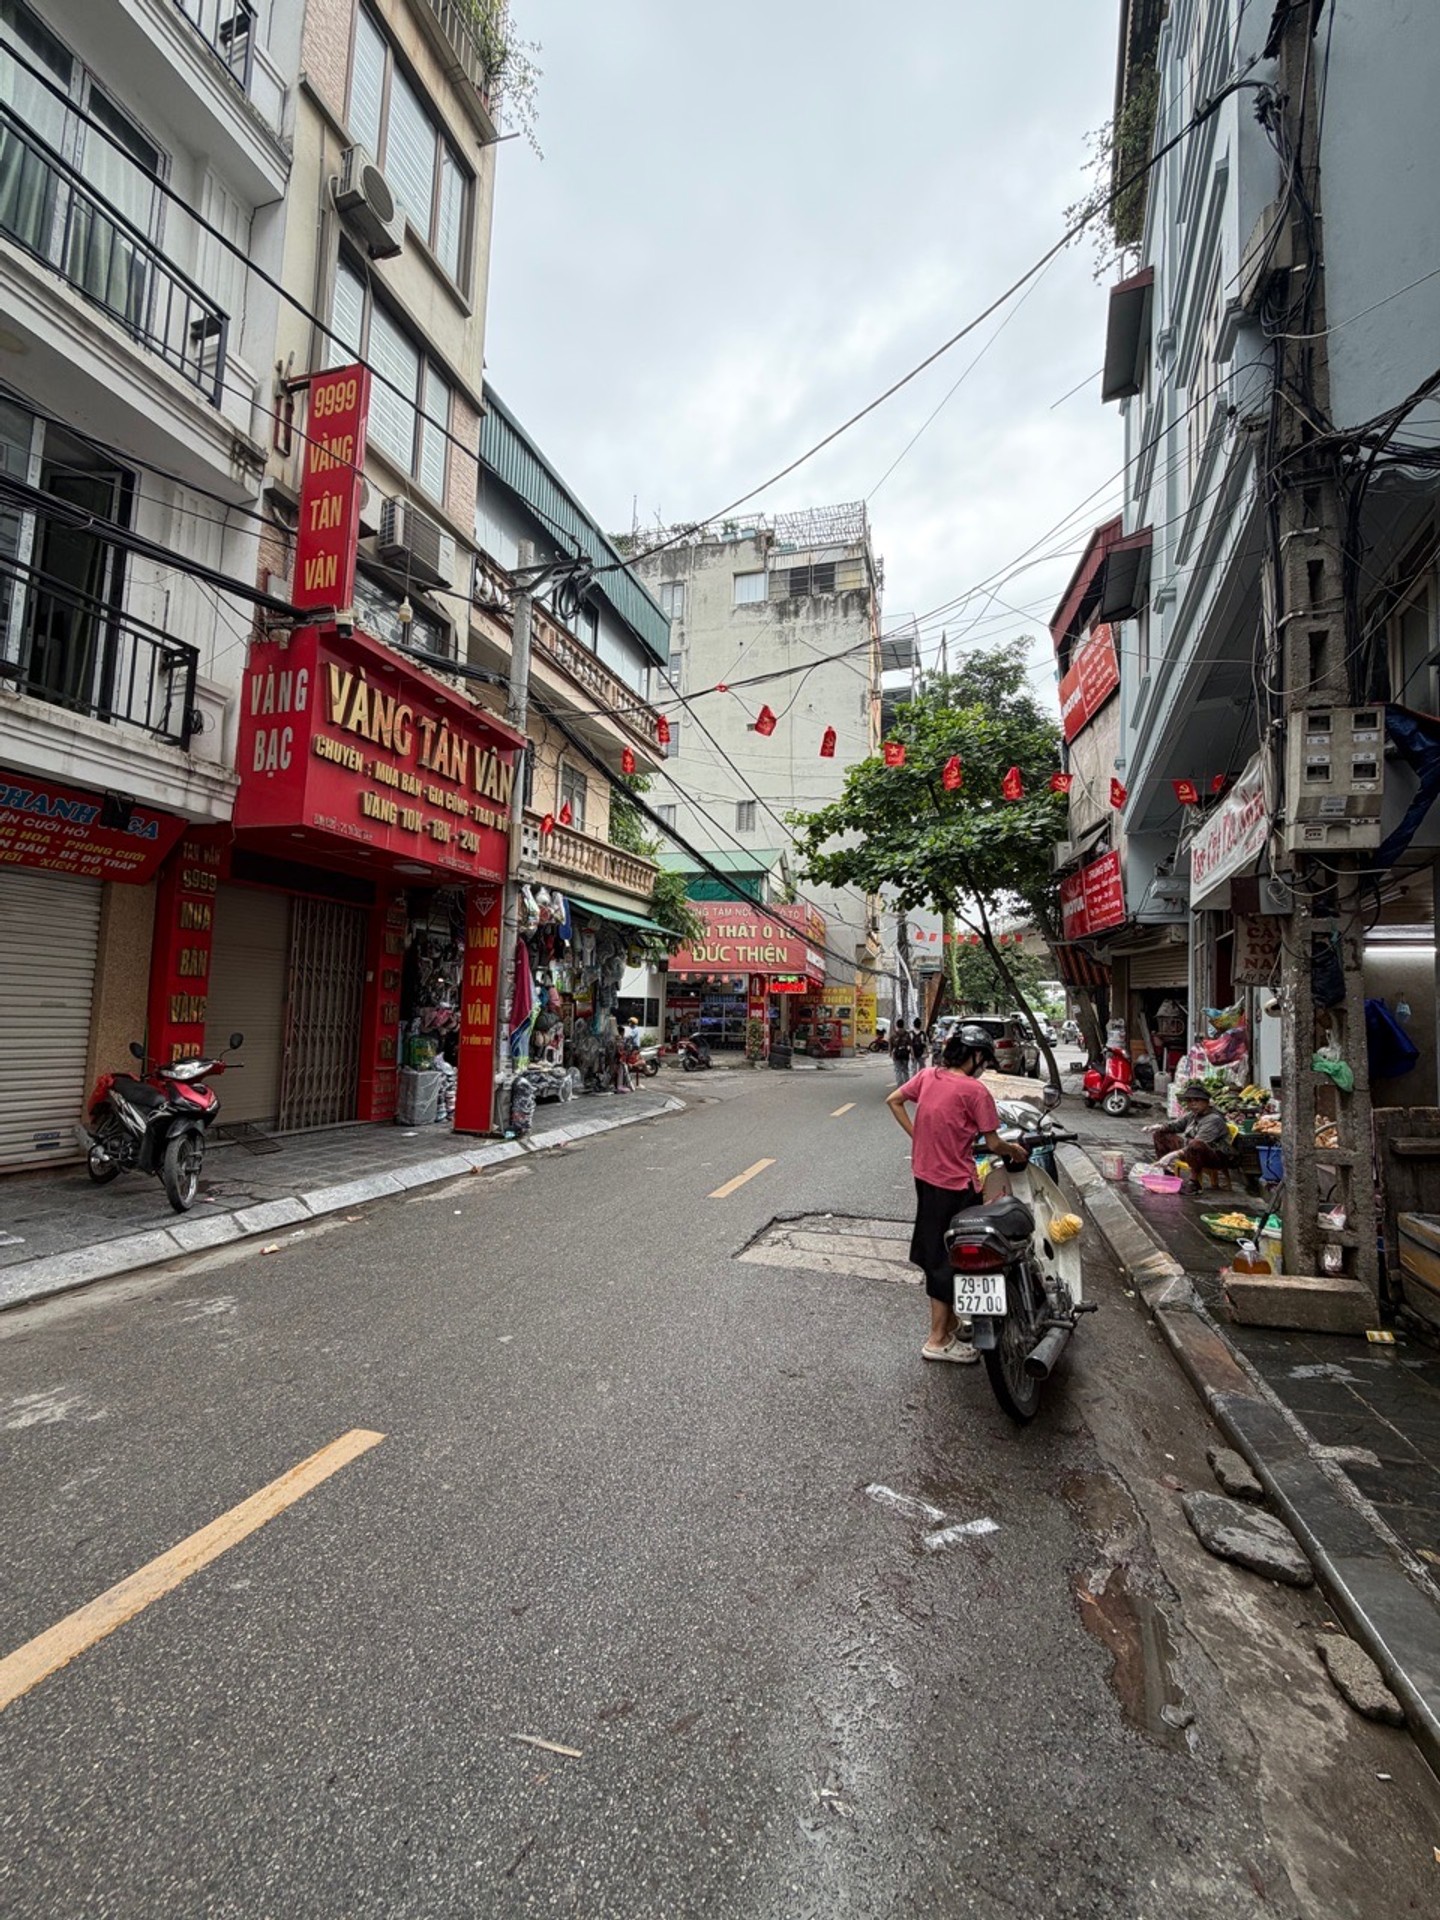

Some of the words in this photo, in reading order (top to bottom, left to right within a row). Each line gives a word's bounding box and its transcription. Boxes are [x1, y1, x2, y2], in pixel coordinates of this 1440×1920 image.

[314, 379, 357, 419] 9999
[310, 432, 353, 474] VÀNG
[310, 491, 343, 531] TÂN
[304, 550, 338, 591] VÂN
[251, 664, 309, 716] VÀNG
[327, 662, 414, 756] VÀNG
[417, 717, 470, 785] TÂN
[473, 745, 514, 806] VÂN
[253, 726, 294, 778] BẠC
[314, 733, 364, 773] CHUYÊN
[373, 761, 399, 788] MUA
[400, 772, 422, 798] BÁN
[427, 785, 445, 808] GIA
[445, 792, 469, 817] CÔNG
[473, 805, 495, 828] TRAO
[23, 815, 61, 834] CƯỚI
[63, 825, 90, 839] HỎI
[361, 790, 398, 824] VÀNG
[400, 807, 424, 832] 10K
[431, 819, 451, 843] 18K
[459, 829, 481, 853] 24K
[14, 841, 48, 855] DÂU
[20, 831, 50, 843] HOA
[40, 857, 78, 873] XÍCH
[183, 869, 217, 891] 9999
[180, 901, 212, 931] MUA
[467, 922, 498, 949] VÀNG
[717, 921, 758, 938] THẤT
[762, 923, 774, 939] Ô
[692, 942, 731, 964] ĐỨC
[734, 943, 788, 966] THIỆN
[470, 961, 493, 987] TÂN
[467, 999, 491, 1026] VÂN
[958, 1296, 1003, 1313] 527.00
